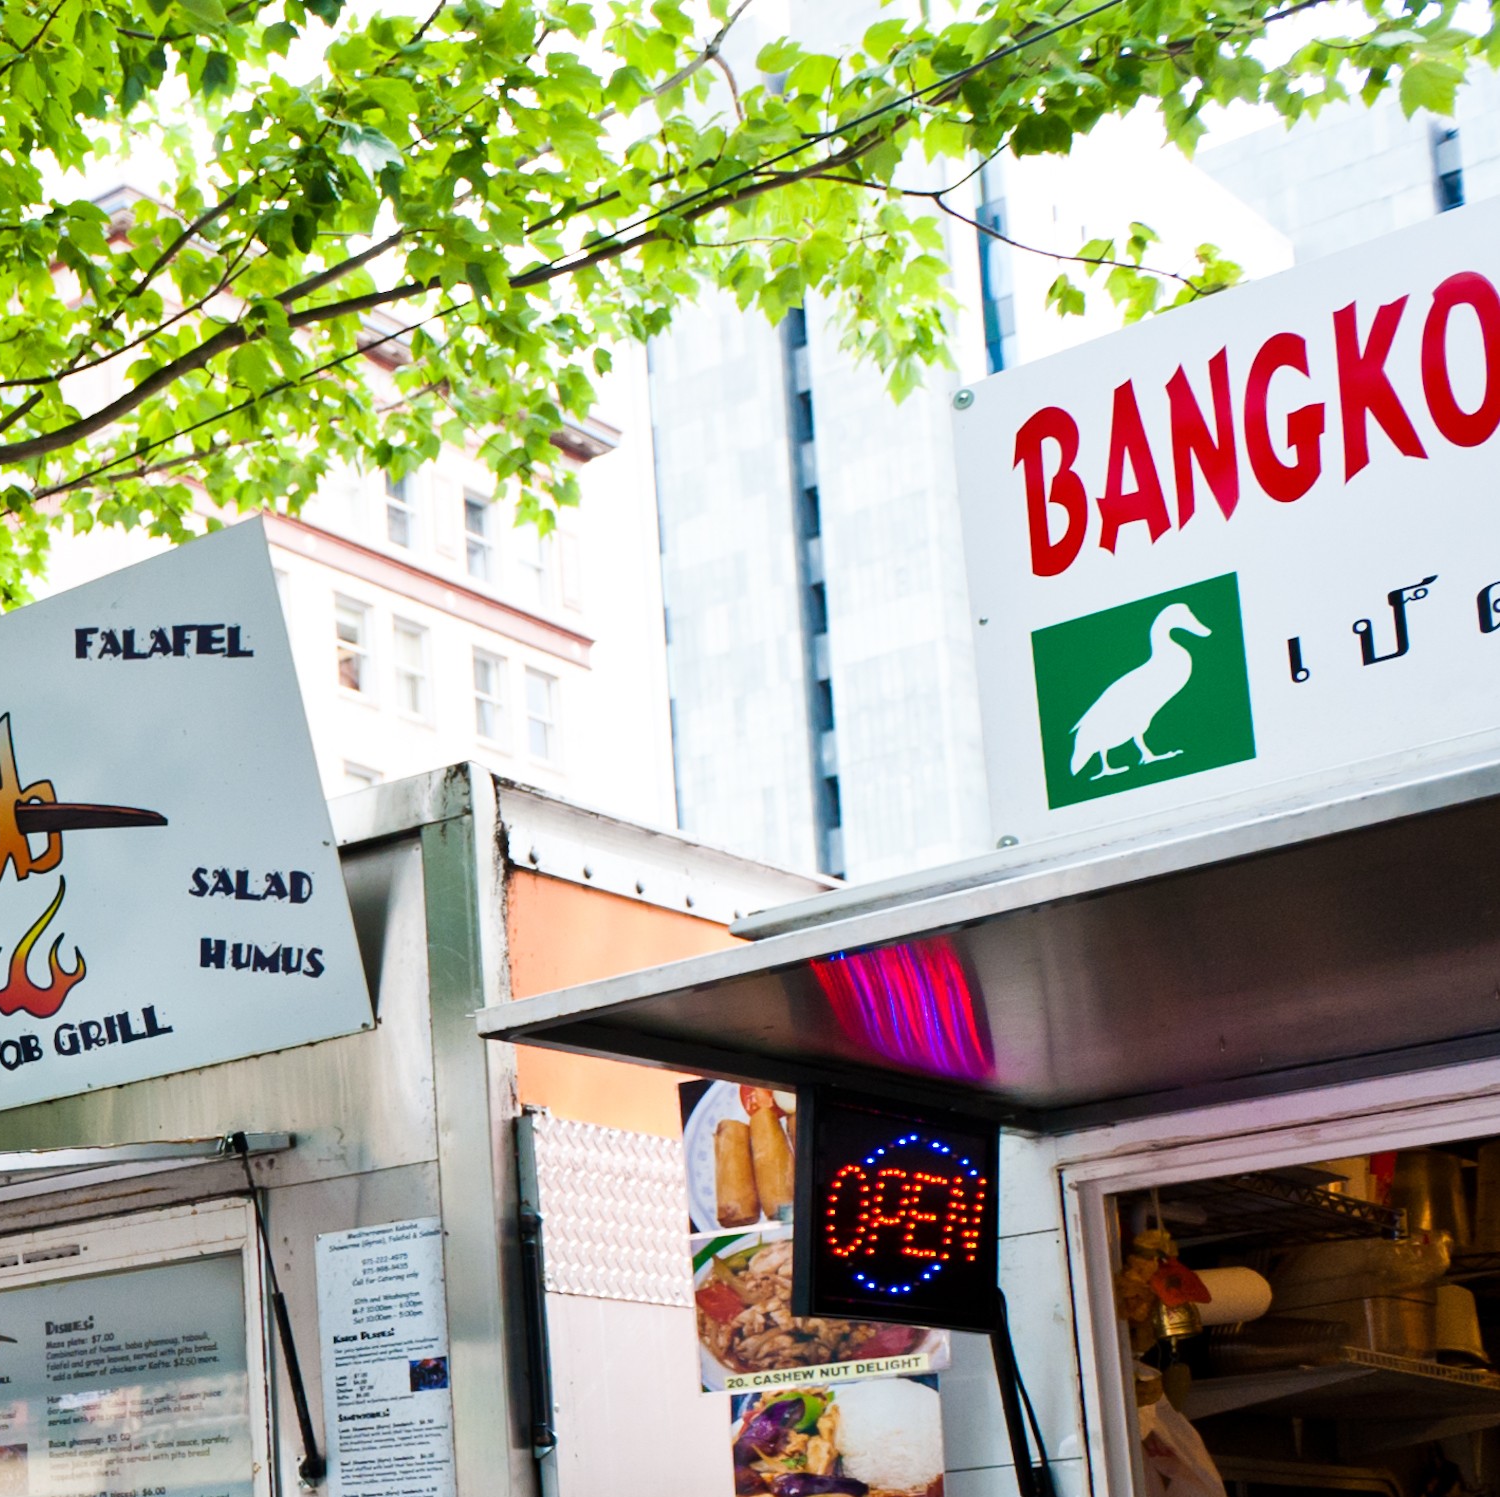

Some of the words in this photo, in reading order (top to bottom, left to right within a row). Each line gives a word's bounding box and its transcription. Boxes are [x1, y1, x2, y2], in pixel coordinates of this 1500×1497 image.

[75, 623, 253, 660] FALAFEL
[189, 867, 312, 903] SALAD
[200, 938, 324, 978] HUMUS
[54, 1005, 173, 1057] GRILL
[826, 1164, 987, 1262] OPEN
[727, 1377, 749, 1389] 20.
[753, 1370, 815, 1386] CASHEW
[820, 1365, 851, 1377] NUT
[856, 1356, 922, 1374] DELIGHT
